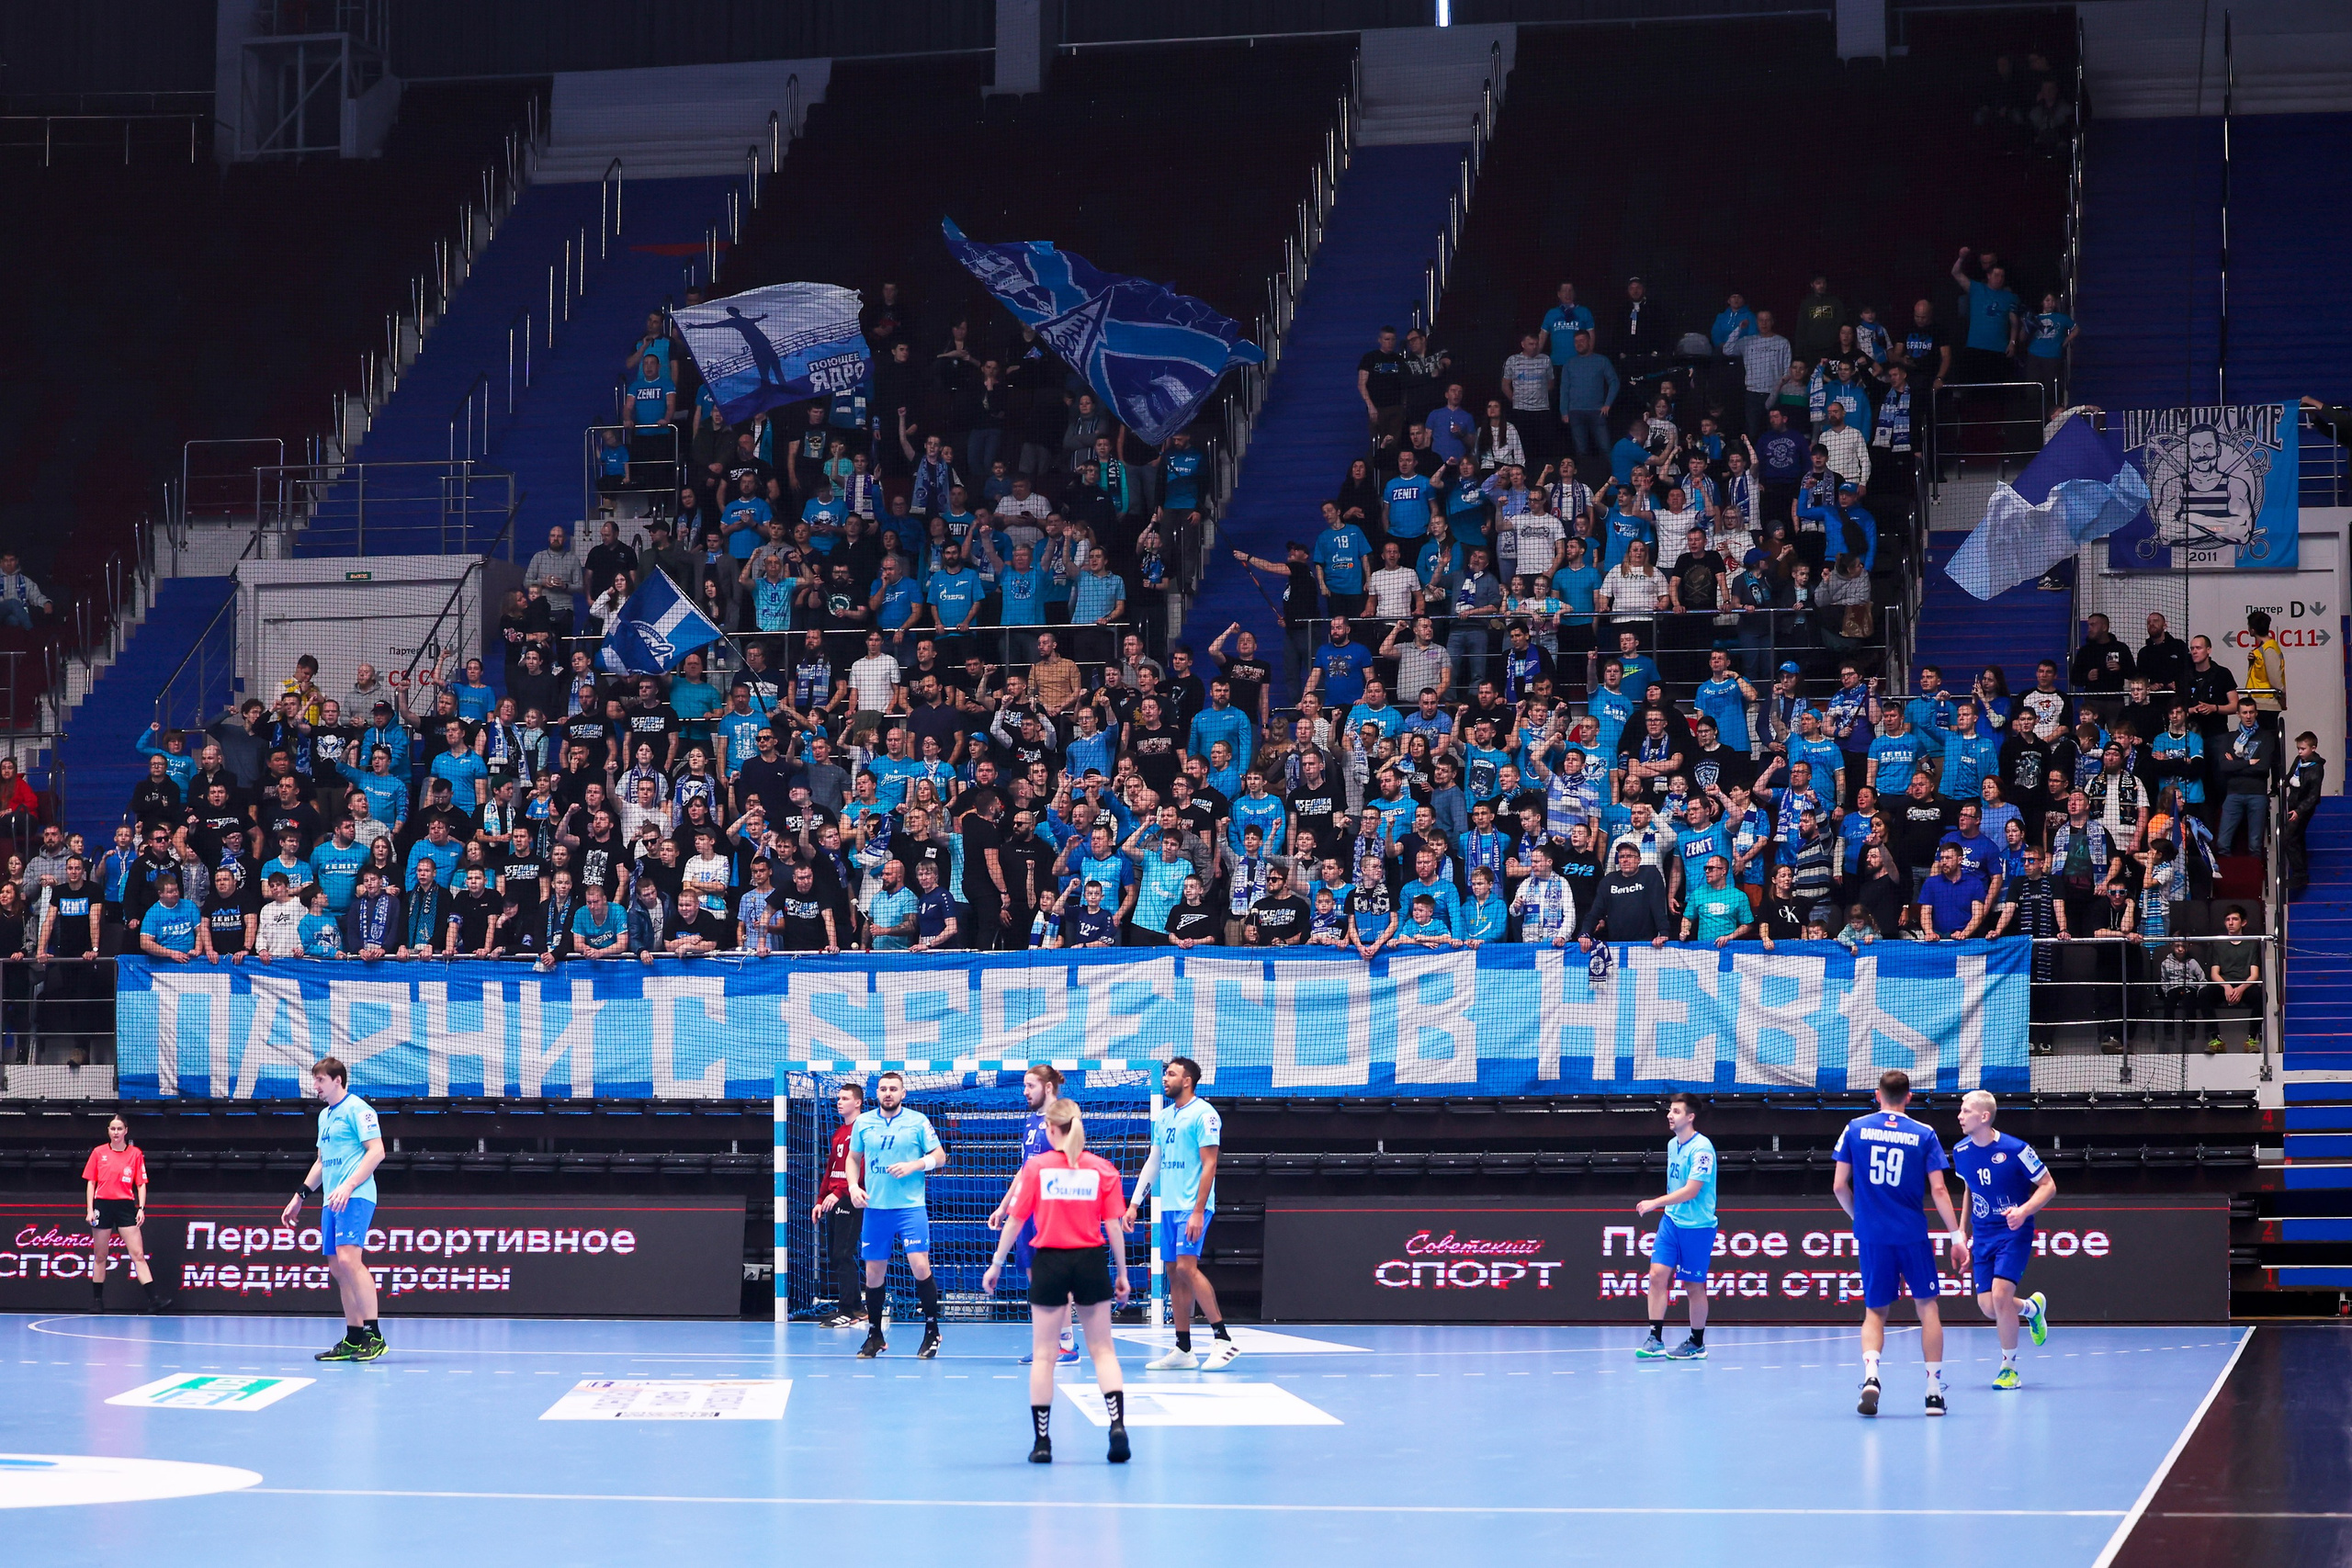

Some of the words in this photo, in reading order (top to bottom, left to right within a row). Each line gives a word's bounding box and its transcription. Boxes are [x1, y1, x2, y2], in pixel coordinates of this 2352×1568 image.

[808, 353, 860, 372] ПОЮЩЕЕ
[809, 362, 865, 393] ЯДРО
[637, 388, 662, 400] ZENIT
[1393, 488, 1419, 501] ZENIT
[2188, 552, 2217, 561] 2011
[2290, 601, 2305, 617] D
[1685, 837, 1713, 857] ZENIT
[1562, 863, 1594, 876] 1312
[61, 899, 87, 915] ZENIT
[1080, 922, 1091, 936] 12
[151, 971, 605, 1100] ПАРНИ
[643, 976, 726, 1100] С
[783, 950, 1477, 1088] БЕРЕГОВ
[1534, 945, 1986, 1091] НЕВЫ
[880, 1134, 896, 1150] 77
[1166, 1127, 1176, 1145] 23
[1860, 1127, 1919, 1146] BAHDANOVICH
[1670, 1162, 1679, 1179] 25
[1869, 1145, 1905, 1187] 59
[1976, 1168, 1992, 1186] 19
[1058, 1188, 1092, 1196] GAZPROM
[187, 1222, 322, 1256] Перво
[364, 1229, 636, 1258] спортивное
[1406, 1234, 1540, 1255] Советский
[1602, 1226, 1790, 1257] Певое
[184, 1264, 330, 1293] медиа
[368, 1267, 511, 1295] траны
[1375, 1261, 1562, 1287] СПОРТ
